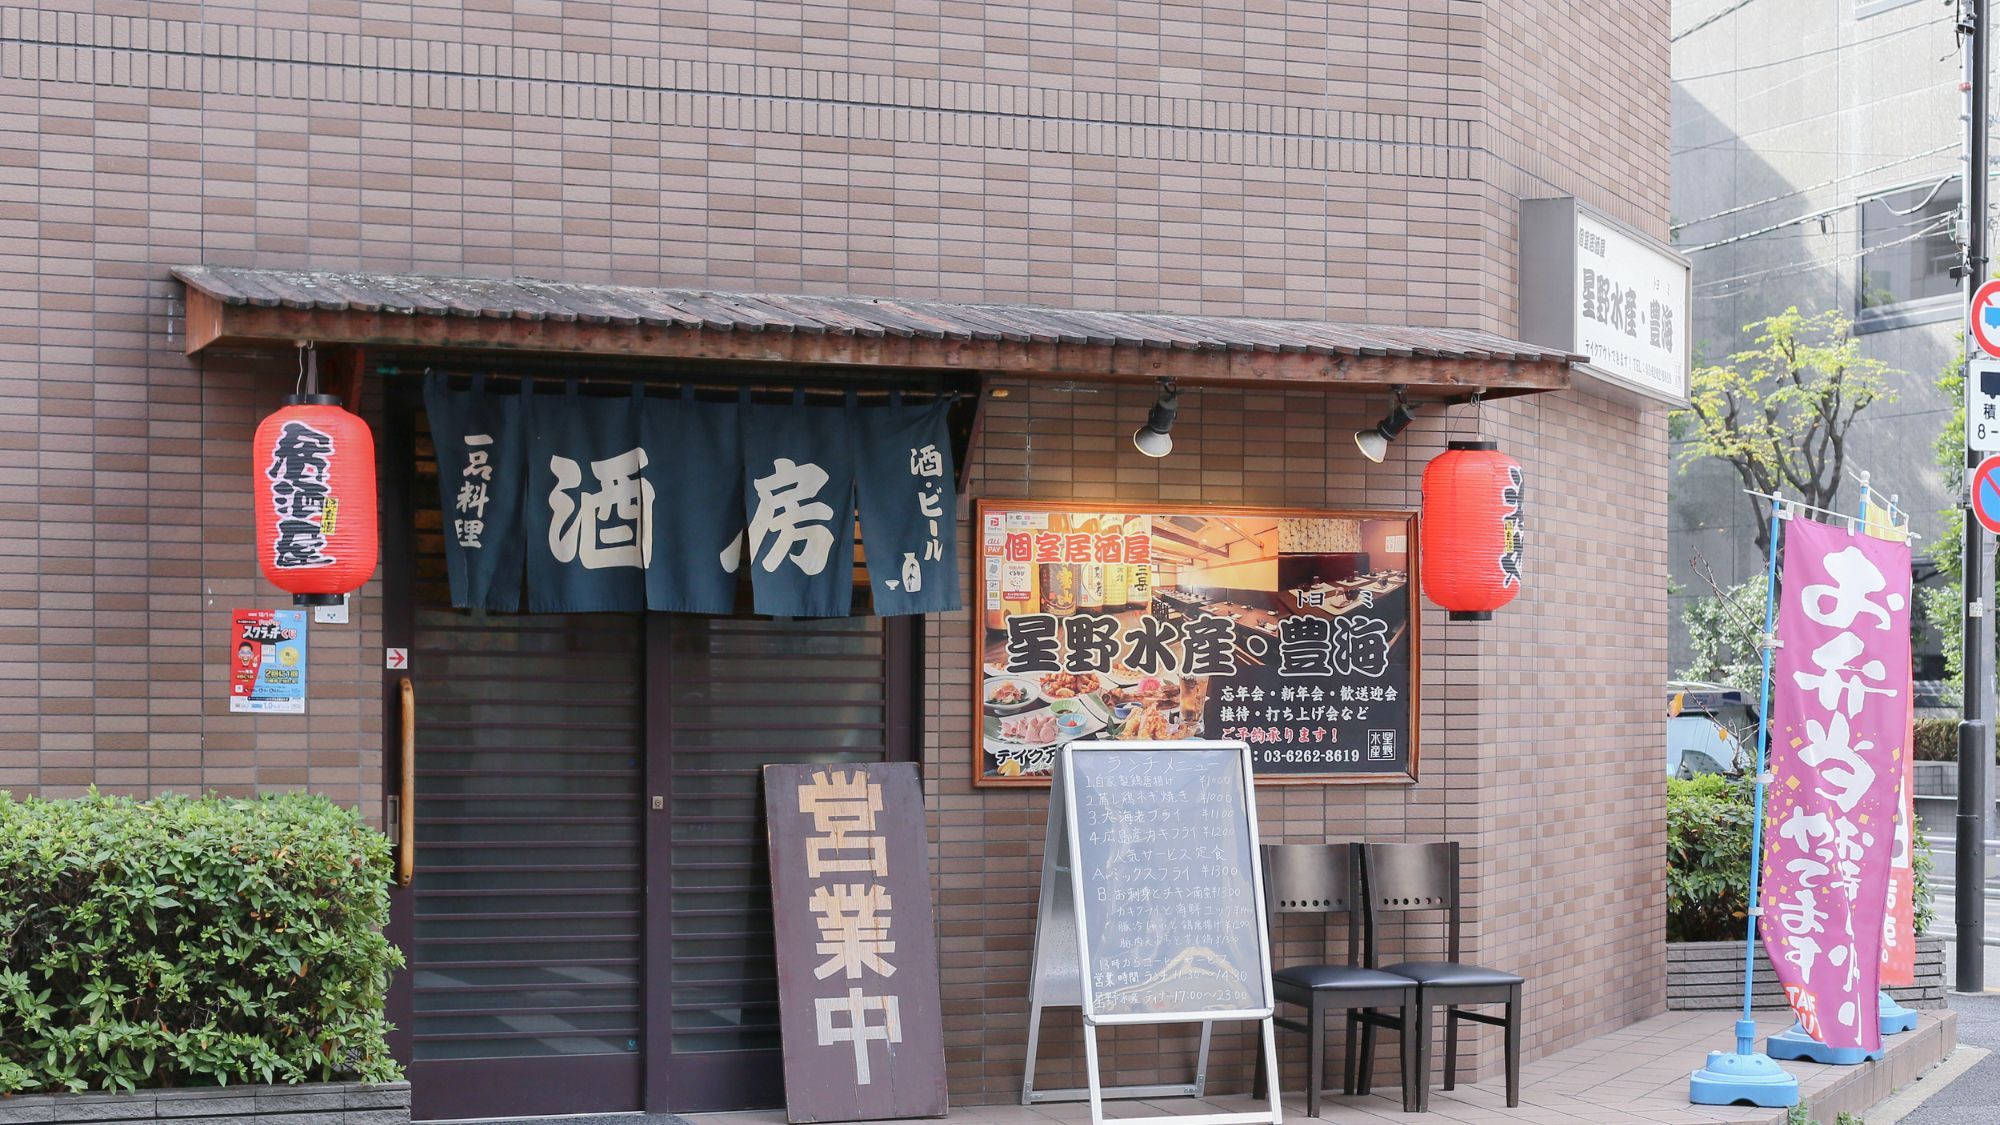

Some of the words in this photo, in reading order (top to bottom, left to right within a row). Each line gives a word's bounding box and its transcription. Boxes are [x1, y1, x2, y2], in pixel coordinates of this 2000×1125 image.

[1582, 268, 1673, 354] 星野水産・豊海
[268, 422, 334, 568] 居酒屋
[454, 434, 494, 548] 一品料理
[548, 446, 835, 577] 酒房
[910, 443, 944, 562] 酒・ビール
[1005, 531, 1151, 564] 個室居酒屋
[1296, 590, 1325, 608] トヨ
[1362, 591, 1375, 608] ミ
[242, 625, 297, 640] スクラッチくじ
[1006, 613, 1389, 677] 星野水産・豊海
[1221, 685, 1398, 702] 忘年会・新年会・歓送迎会
[1792, 545, 1905, 813] お弁当
[1220, 706, 1370, 722] 接待・打ち上げ会など
[1221, 726, 1338, 744] ご予約承ります!
[1107, 756, 1221, 775] ランチメニュー
[1113, 845, 1228, 864] 人気サービス定食
[1779, 806, 1835, 985] やってます
[798, 770, 903, 1085] 営業中
[1094, 972, 1139, 988] 営業時間
